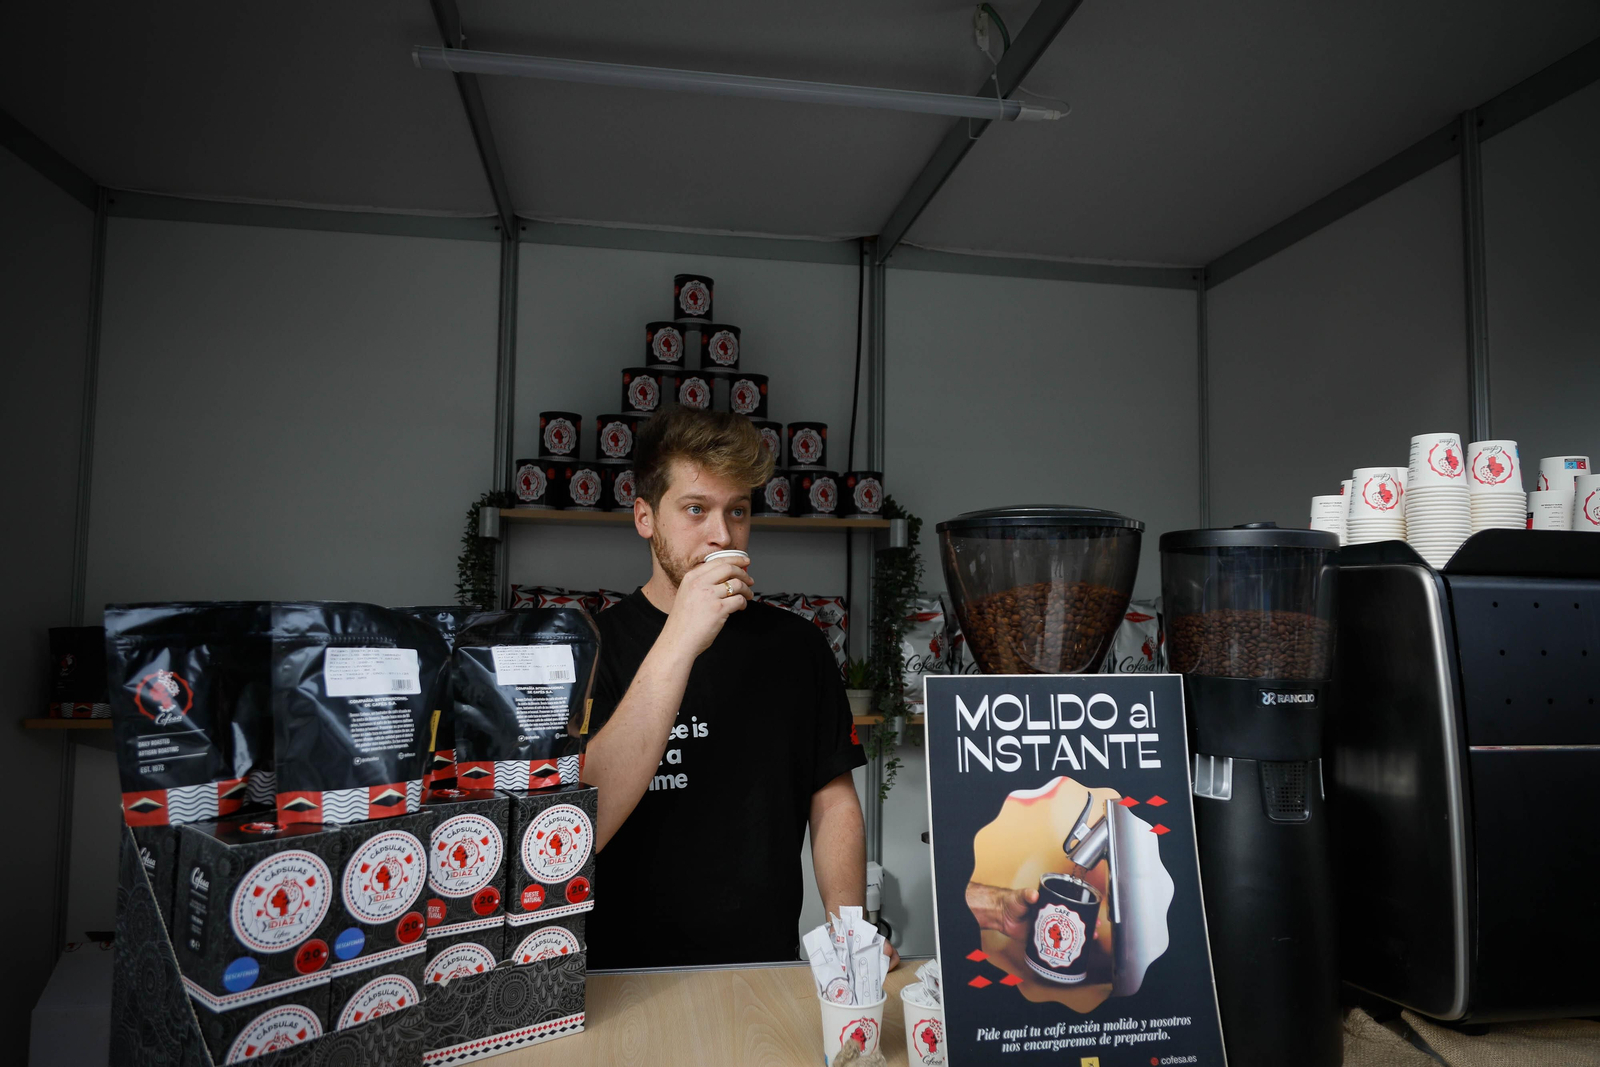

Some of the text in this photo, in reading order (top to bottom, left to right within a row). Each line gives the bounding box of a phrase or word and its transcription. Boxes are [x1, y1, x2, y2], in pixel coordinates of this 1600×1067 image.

[905, 654, 944, 676] Cofesa
[1278, 694, 1315, 703] RANCILIO
[956, 691, 1156, 731] MOLIDO al
[692, 716, 709, 738] is
[666, 748, 682, 765] a
[957, 734, 1162, 772] INSTANTE
[549, 856, 567, 865] DIAZ
[452, 869, 473, 878] DIAZ
[572, 884, 584, 894] 20
[374, 891, 396, 902] DIAZ
[480, 895, 494, 904] 20
[270, 917, 295, 928] DIAZ
[404, 920, 418, 932] 20
[303, 948, 321, 961] 20
[1045, 948, 1066, 960] DIAZ
[976, 1016, 1192, 1042] Pide aquí tu café recién molido y nosotros
[1001, 1029, 1171, 1053] nos encargaremos de prepararlo.
[1160, 1054, 1198, 1065] cofesa.es
